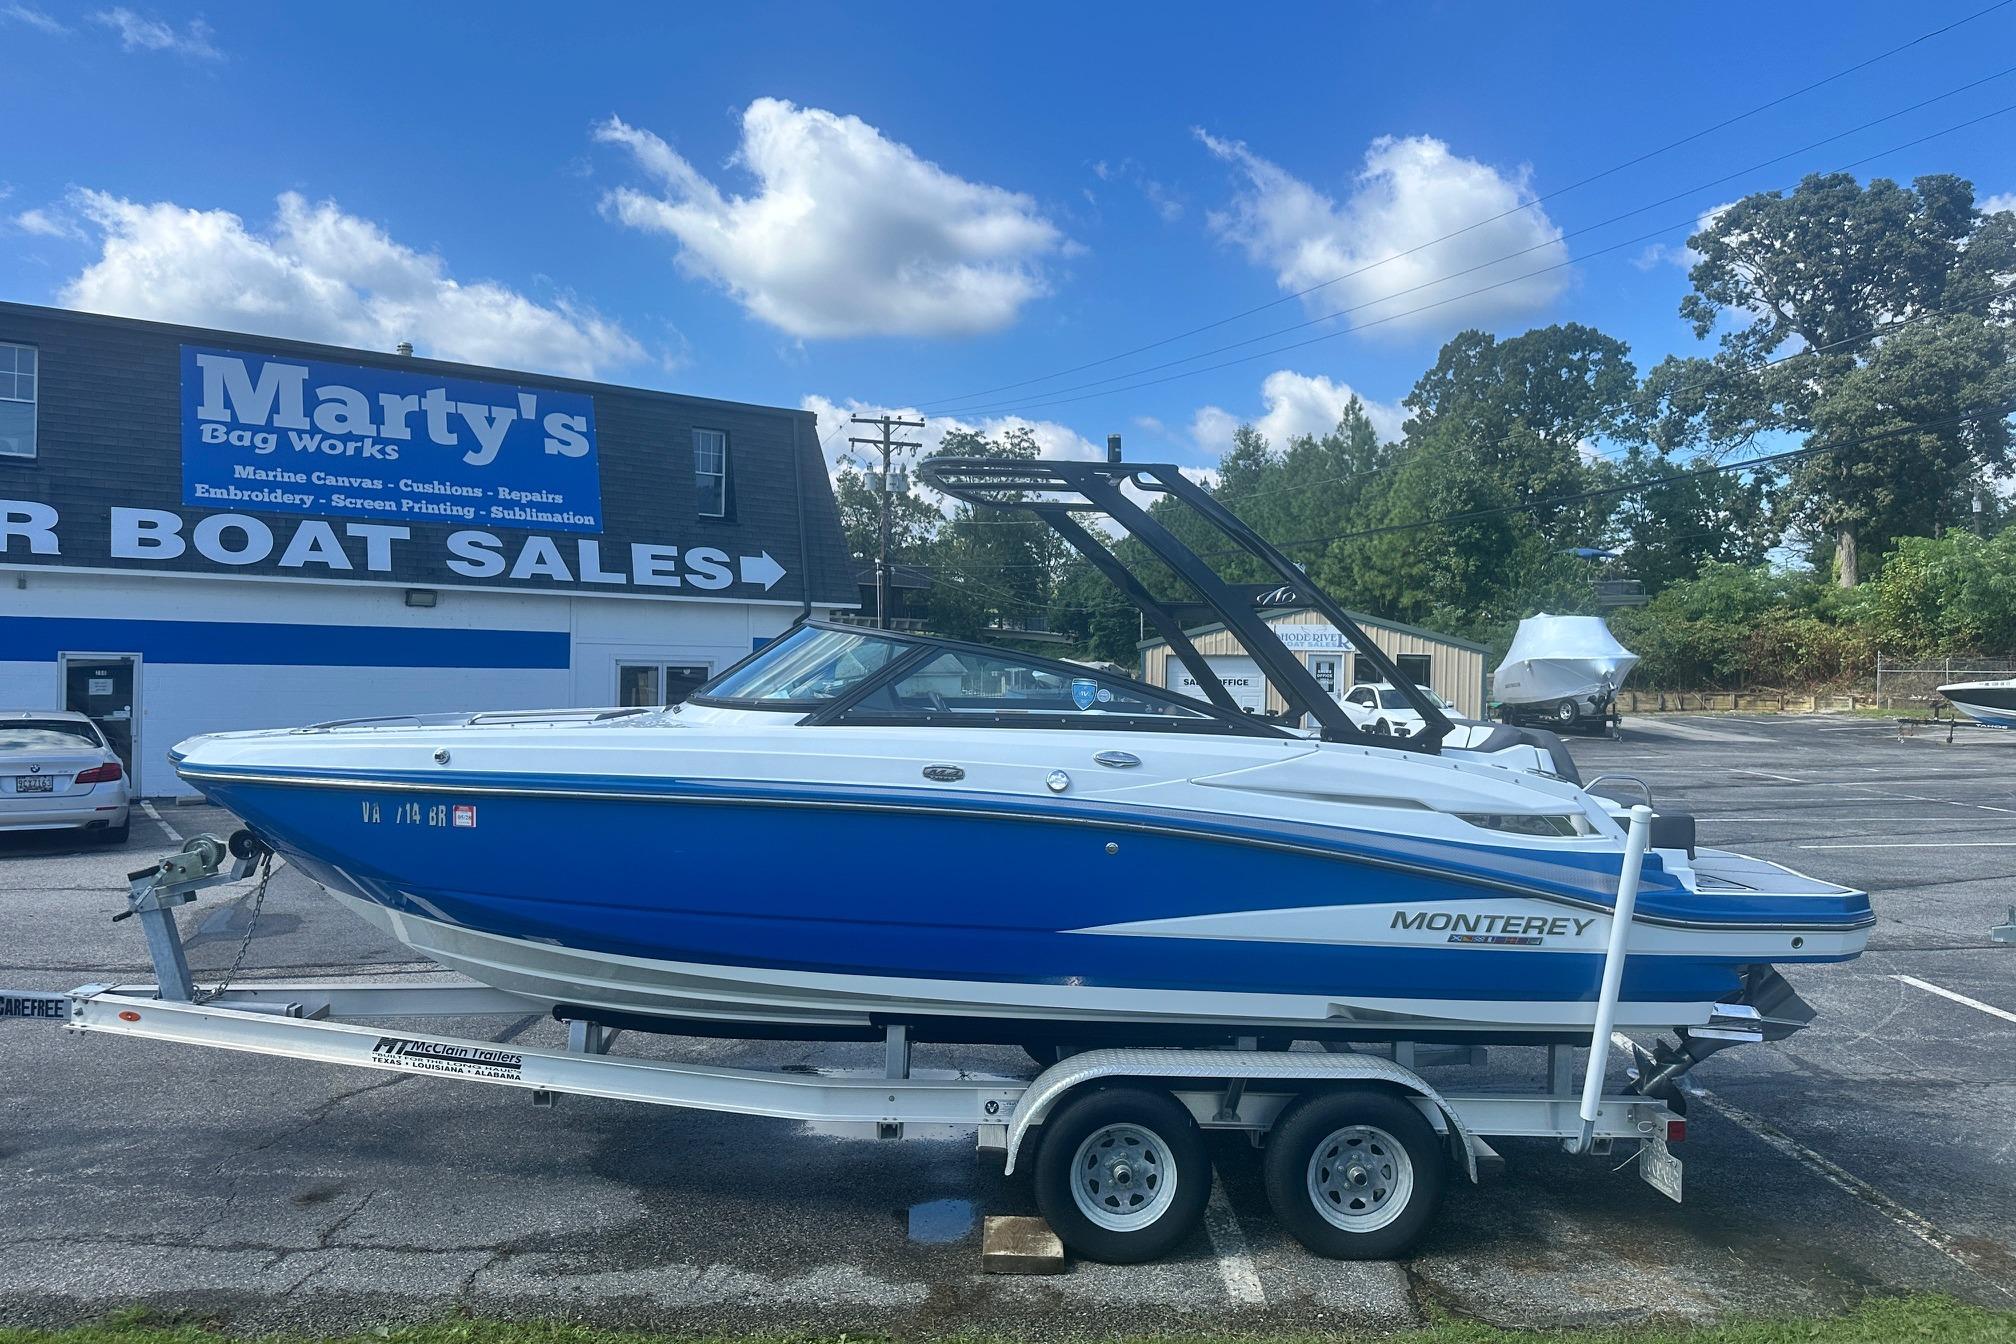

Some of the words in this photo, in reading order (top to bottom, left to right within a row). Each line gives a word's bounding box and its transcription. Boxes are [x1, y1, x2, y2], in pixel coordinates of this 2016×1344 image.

[197, 354, 589, 465] Marty's
[200, 424, 277, 454] Bag
[288, 431, 399, 460] Works
[233, 464, 307, 484] Marine
[311, 471, 383, 490] Canvas
[399, 478, 483, 498] Cushions
[498, 486, 564, 505] Repairs
[194, 483, 314, 508] Embroidery
[331, 494, 398, 511] Screen
[401, 499, 475, 519] Printing
[490, 505, 595, 526] Sublimation
[111, 506, 410, 573] BOAT
[446, 530, 733, 590] SALES
[362, 801, 380, 823] VA
[1390, 911, 1596, 936] MONTEREY
[405, 1055, 424, 1063] FOR
[446, 1060, 482, 1070] LONG
[411, 1041, 468, 1058] McClain
[472, 1048, 522, 1064] Trailers
[372, 1057, 402, 1066] TEXAS
[412, 1062, 464, 1074] LOUISIANA
[474, 1069, 522, 1081] ALABAMA
